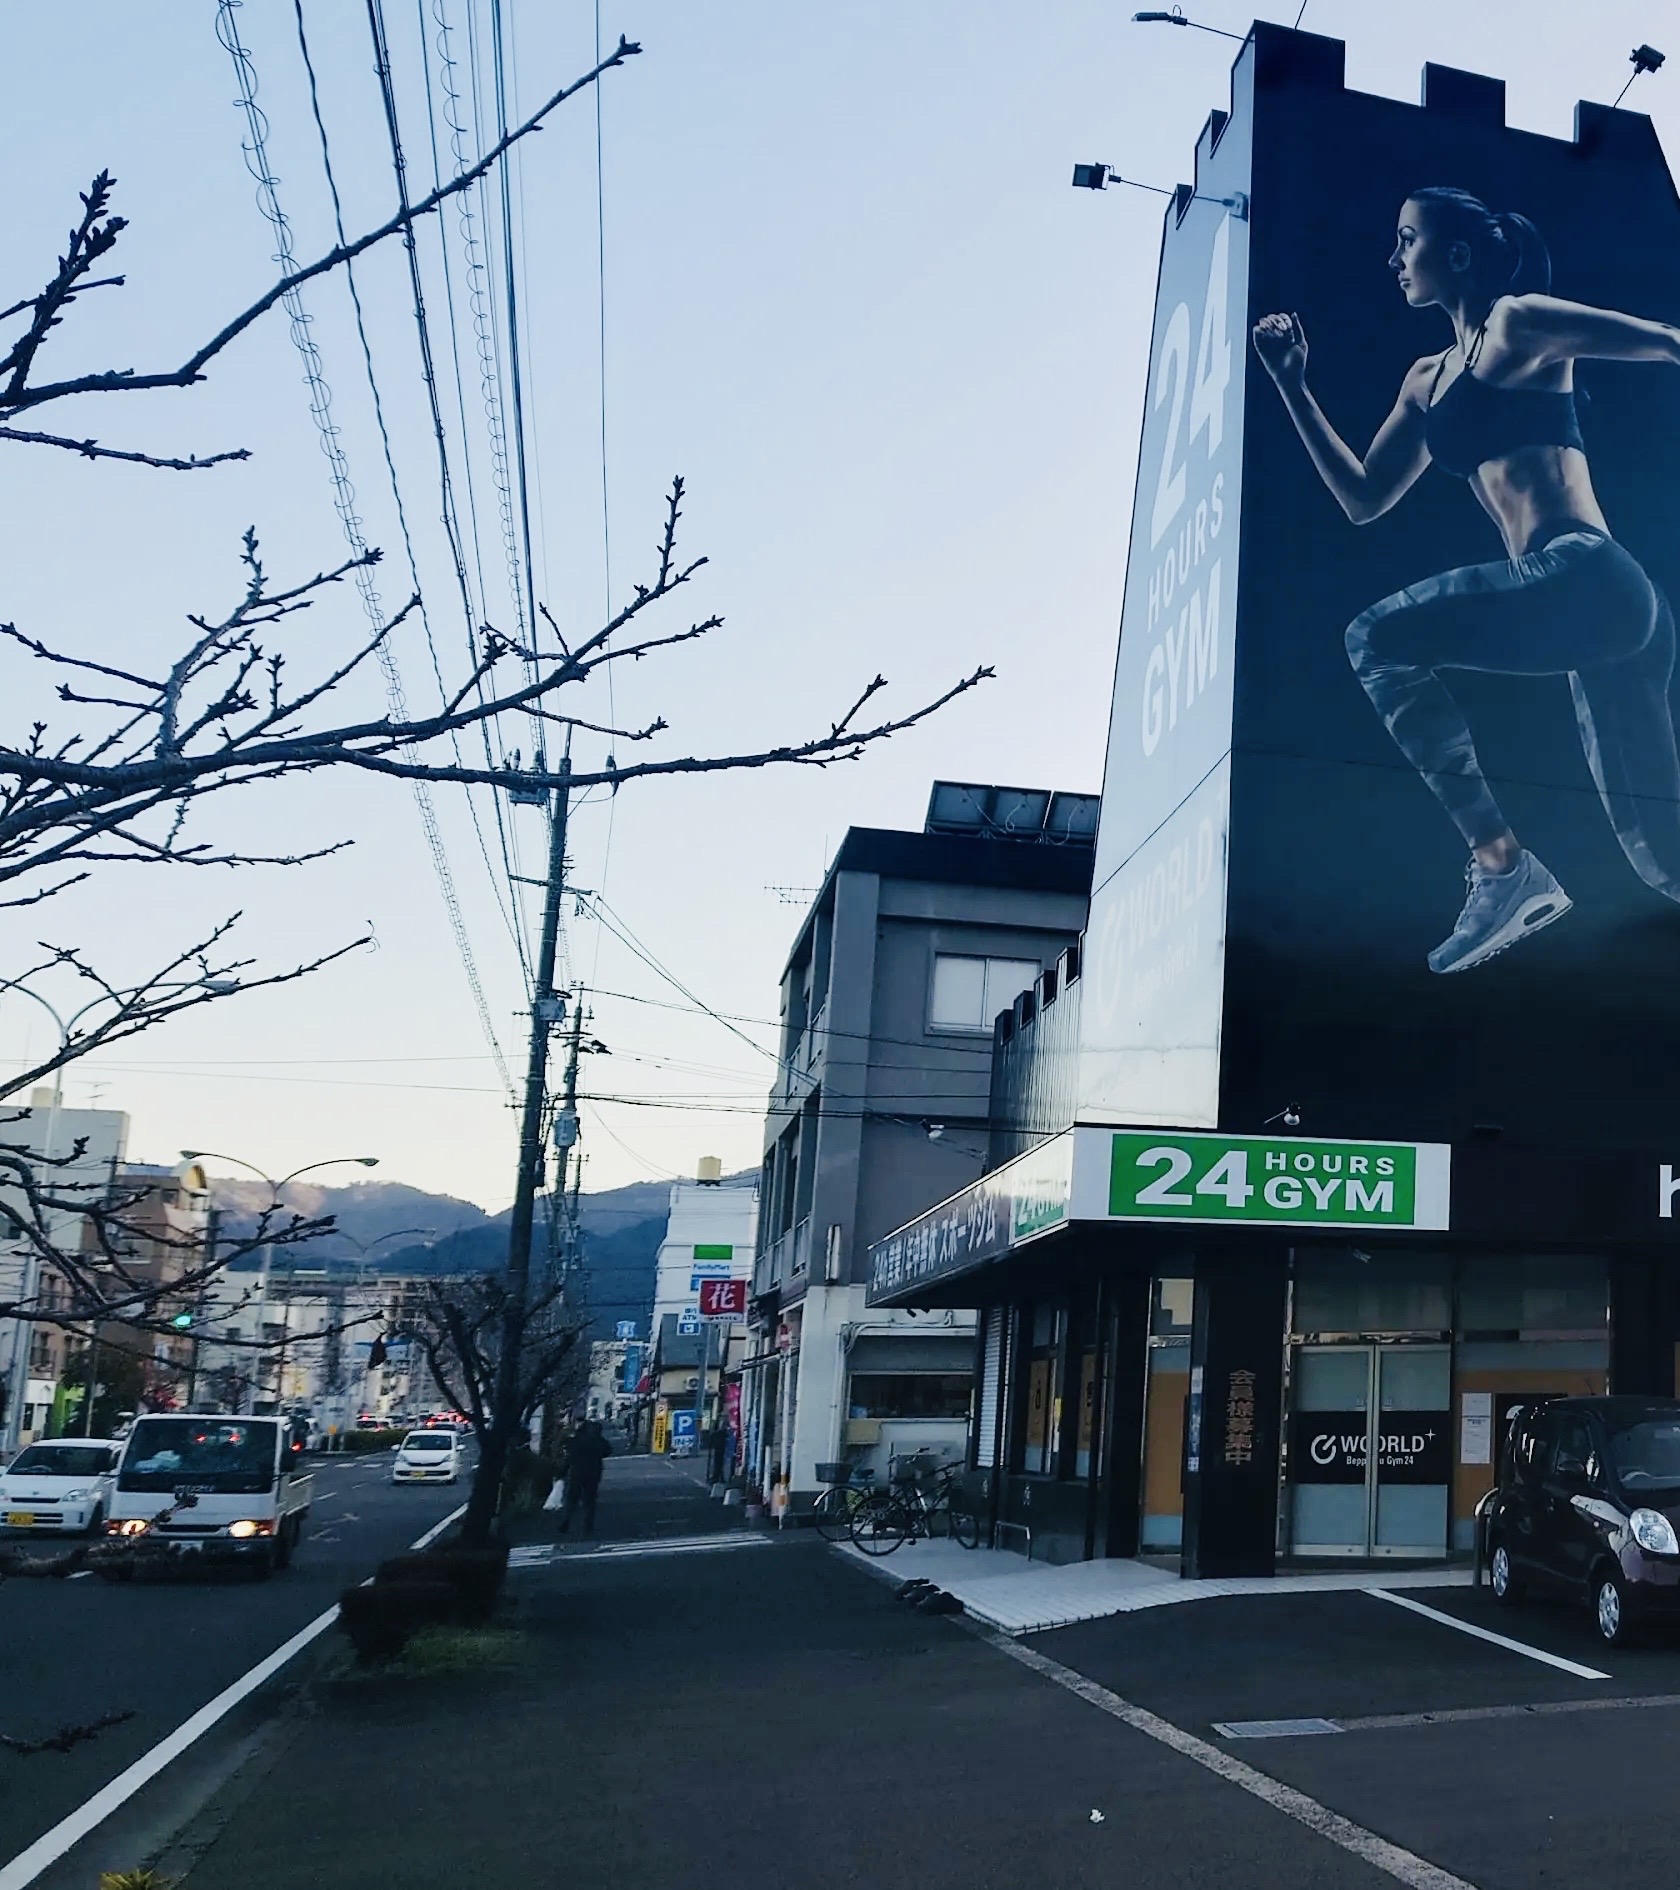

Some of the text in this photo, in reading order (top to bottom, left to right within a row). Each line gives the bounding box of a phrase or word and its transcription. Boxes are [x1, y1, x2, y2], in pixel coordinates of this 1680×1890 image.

[1151, 210, 1231, 550] 24
[1147, 472, 1224, 632] HOURS
[1142, 557, 1221, 757] GYM
[1129, 816, 1214, 960] WORLD
[1135, 1146, 1395, 1213] 24 GYM
[1264, 1152, 1396, 1175] HOURS
[708, 1282, 736, 1310] 花
[678, 1416, 693, 1434] P
[1225, 1369, 1256, 1466] 会員様募集中
[1404, 1455, 1414, 1465] 24
